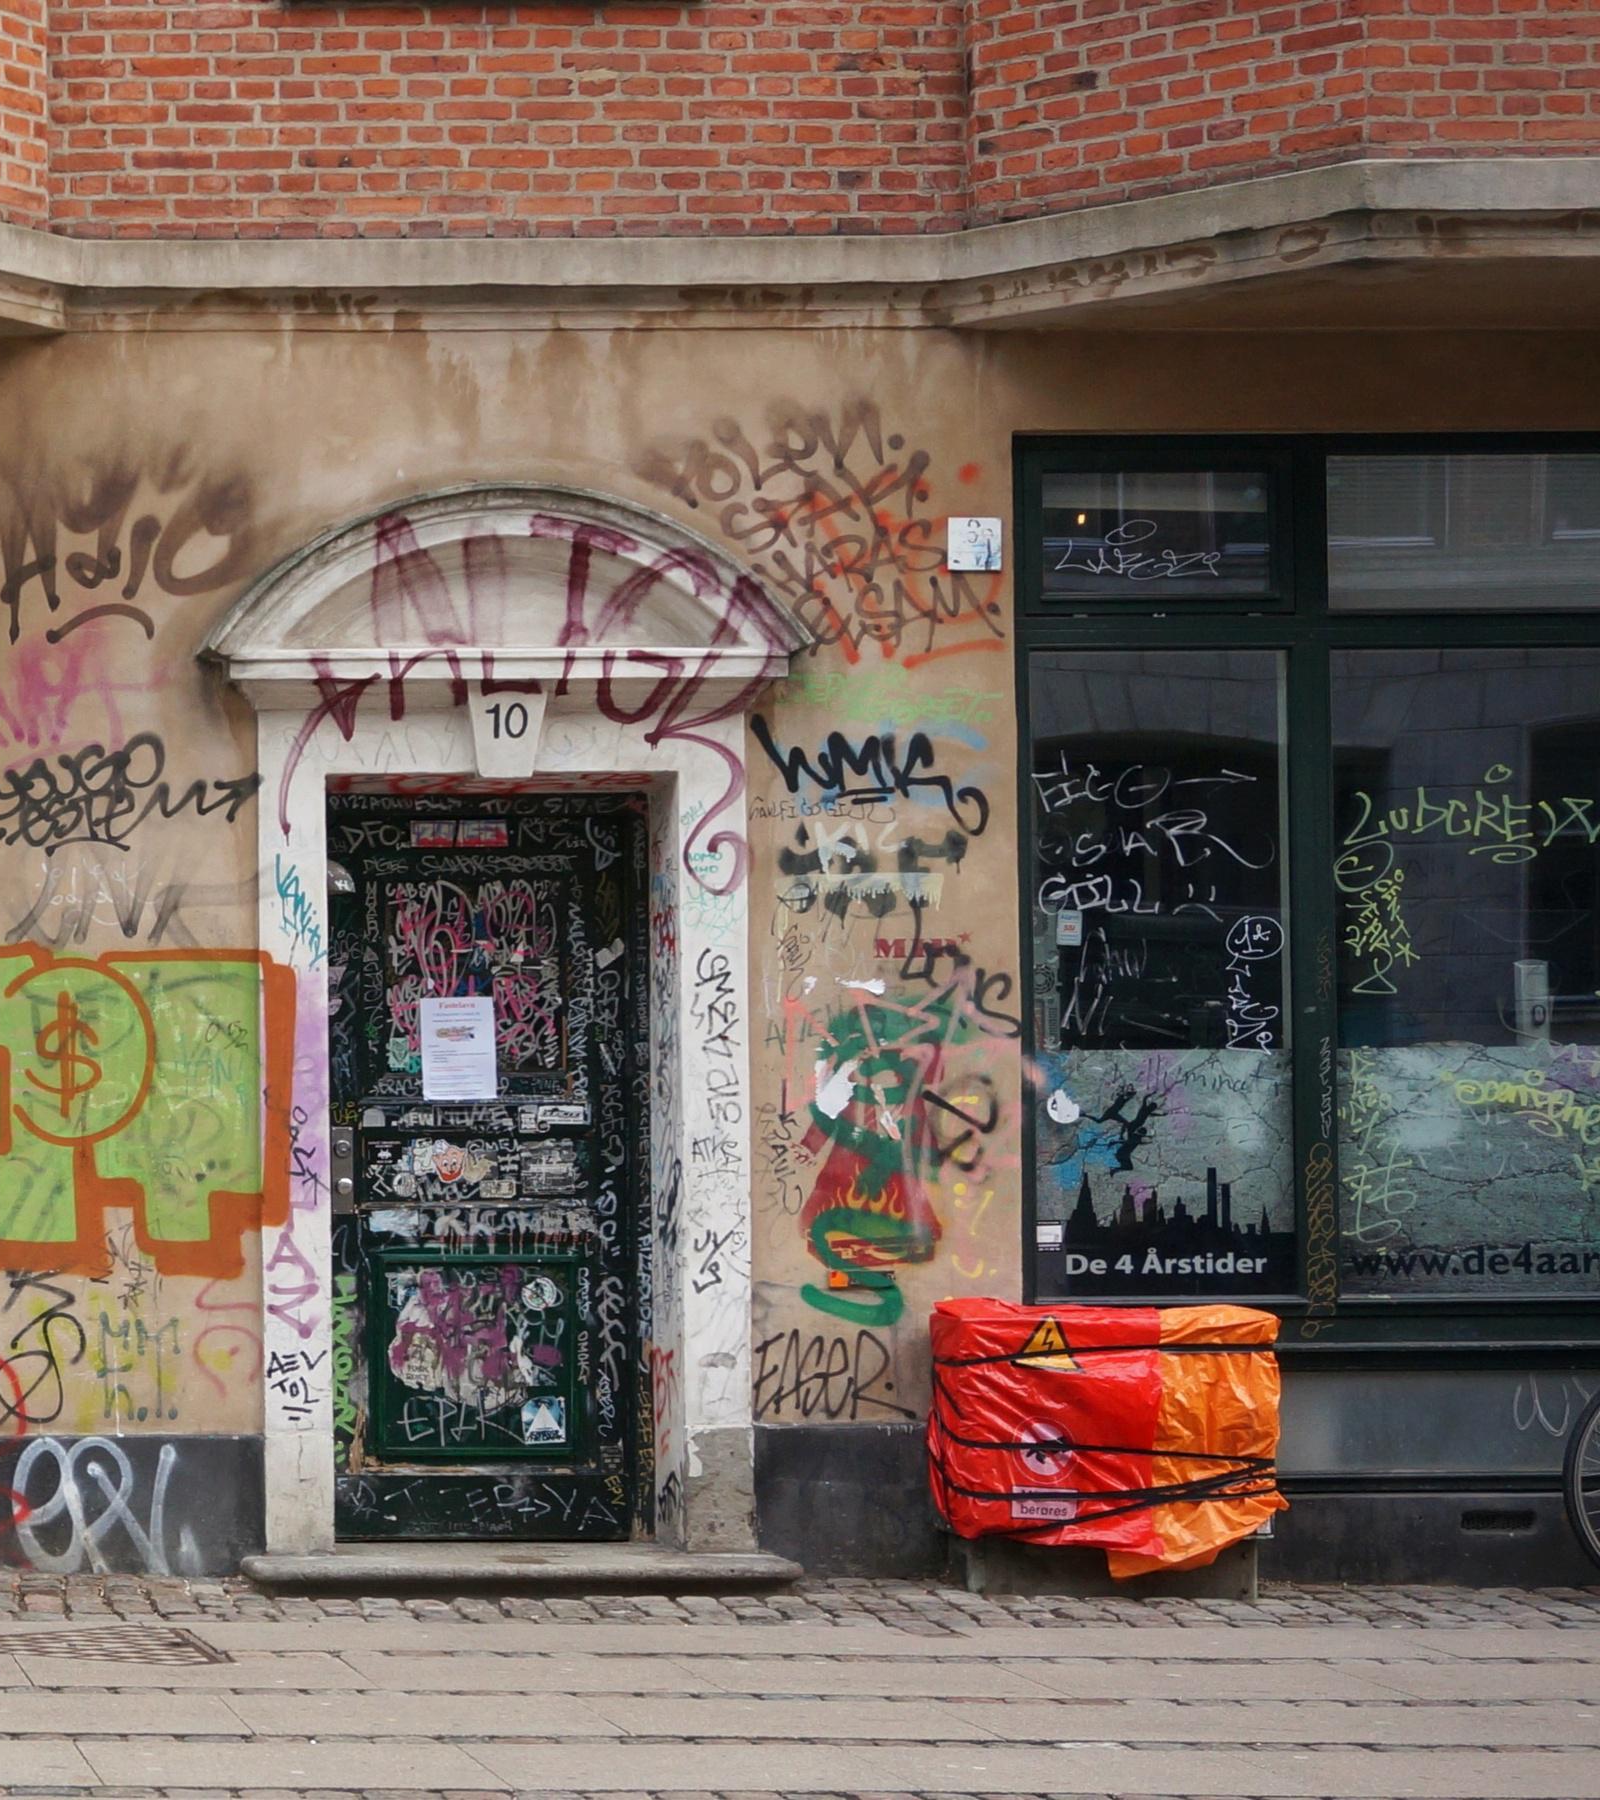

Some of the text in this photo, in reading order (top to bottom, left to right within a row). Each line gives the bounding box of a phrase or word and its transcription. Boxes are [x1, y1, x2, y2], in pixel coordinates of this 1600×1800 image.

[485, 702, 528, 740] 10
[1065, 1247, 1268, 1277] De 4 Årstider
[1344, 1241, 1600, 1275] www.de4aar
